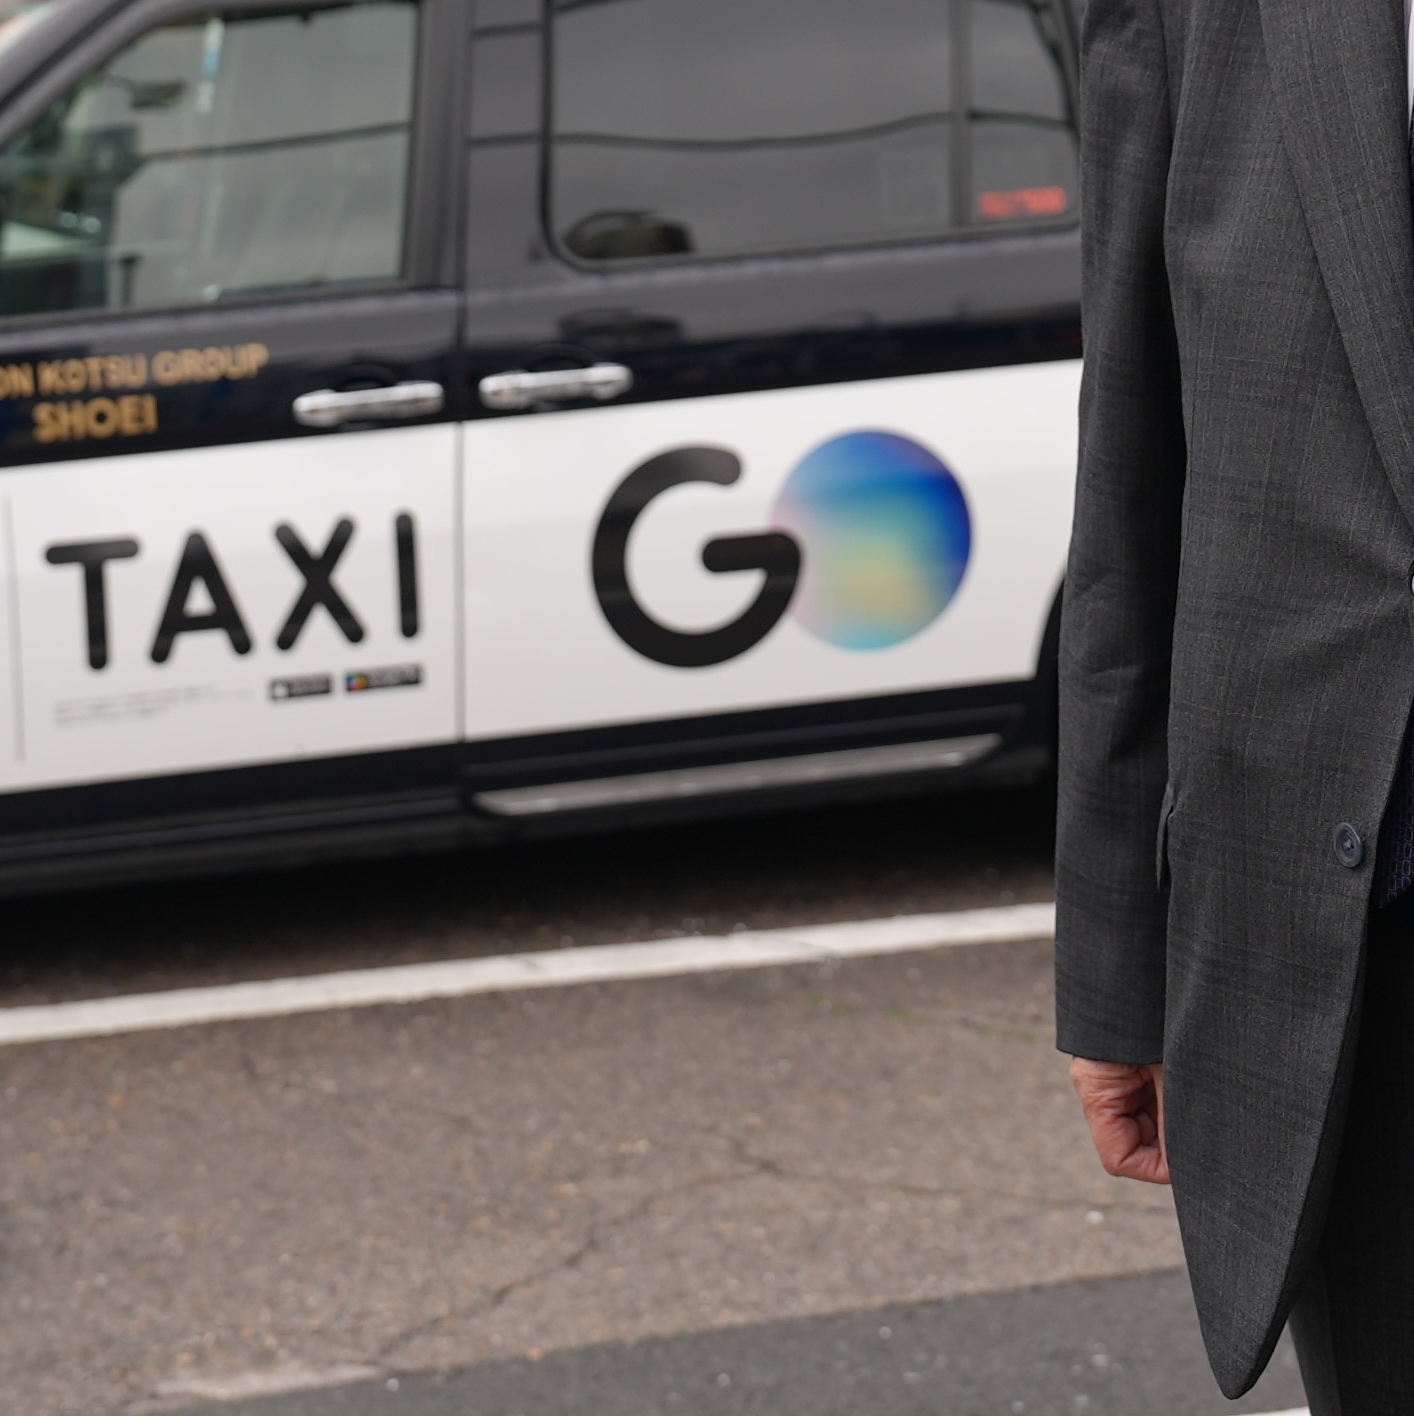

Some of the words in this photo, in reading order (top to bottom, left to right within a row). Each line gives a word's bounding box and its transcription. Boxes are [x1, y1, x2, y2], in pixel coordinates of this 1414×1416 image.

[31, 392, 158, 445] SHOEI
[37, 352, 148, 395] KOTSU
[151, 341, 270, 385] GROUP
[43, 508, 421, 672] TAXI
[590, 427, 974, 669] GO
